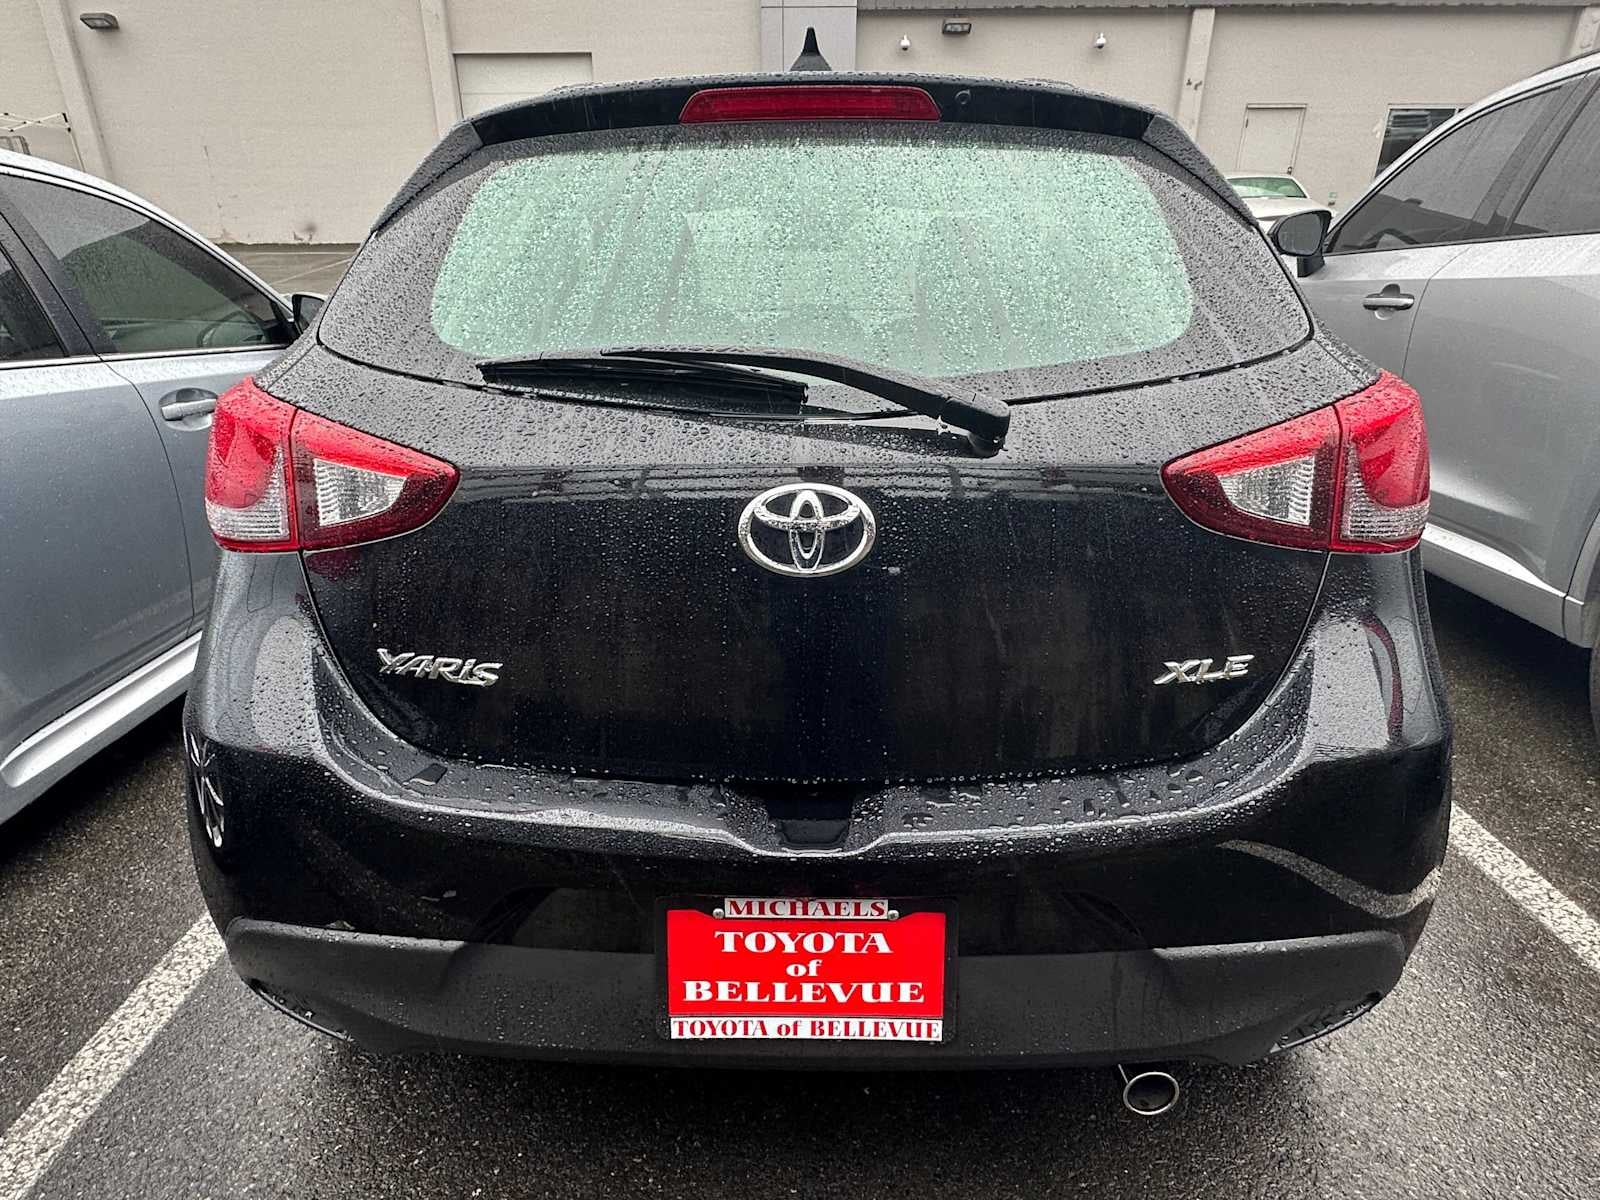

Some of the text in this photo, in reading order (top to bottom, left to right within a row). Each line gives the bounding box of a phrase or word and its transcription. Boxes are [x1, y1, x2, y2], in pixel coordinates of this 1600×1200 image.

[377, 649, 503, 686] YARIS
[1152, 654, 1255, 685] XLE
[728, 900, 885, 917] MICHAELS
[714, 931, 894, 954] TOYOTA
[786, 959, 823, 977] of
[682, 980, 924, 1003] BELLEVUE
[673, 1020, 941, 1039] TOYOTA of BELLEVUE
